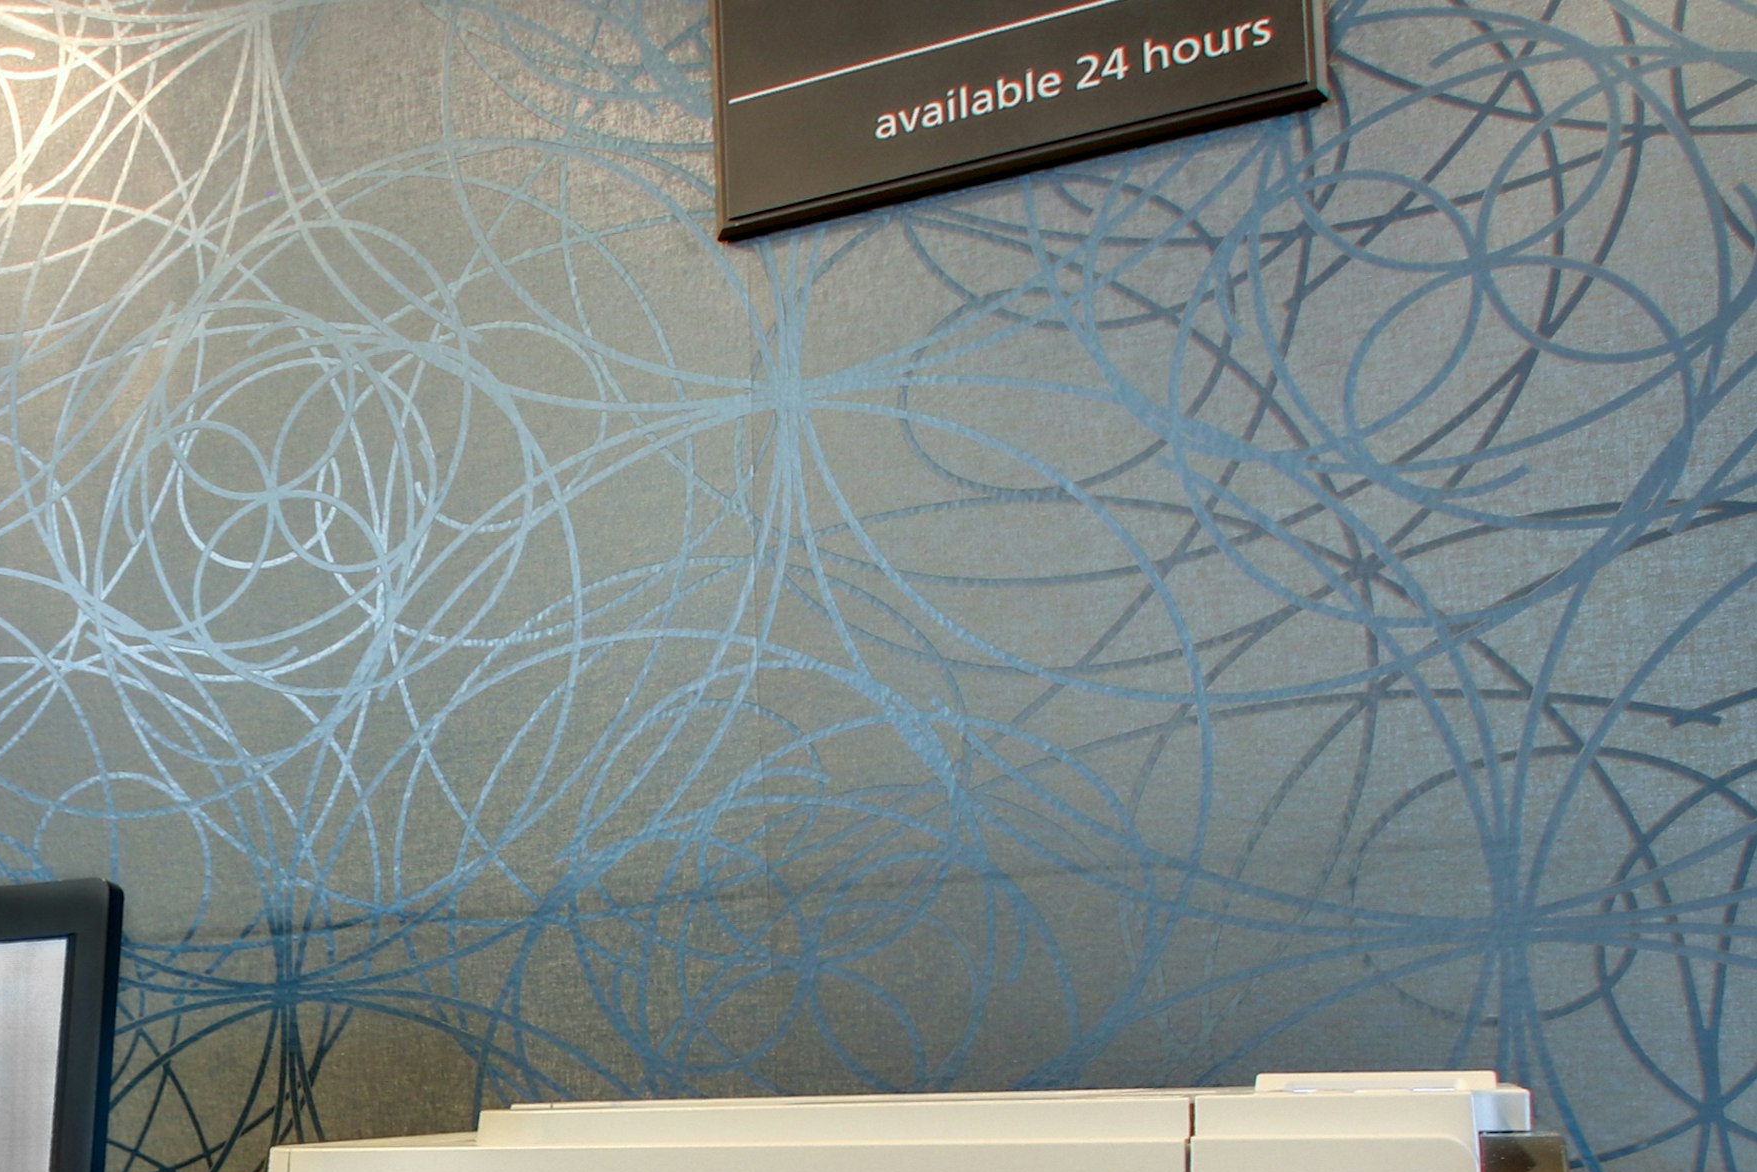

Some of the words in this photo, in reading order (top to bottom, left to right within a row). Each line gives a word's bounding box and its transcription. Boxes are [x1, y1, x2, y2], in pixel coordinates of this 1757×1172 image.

[874, 67, 1063, 140] available
[1075, 44, 1131, 91] 24
[1142, 15, 1275, 74] hours
